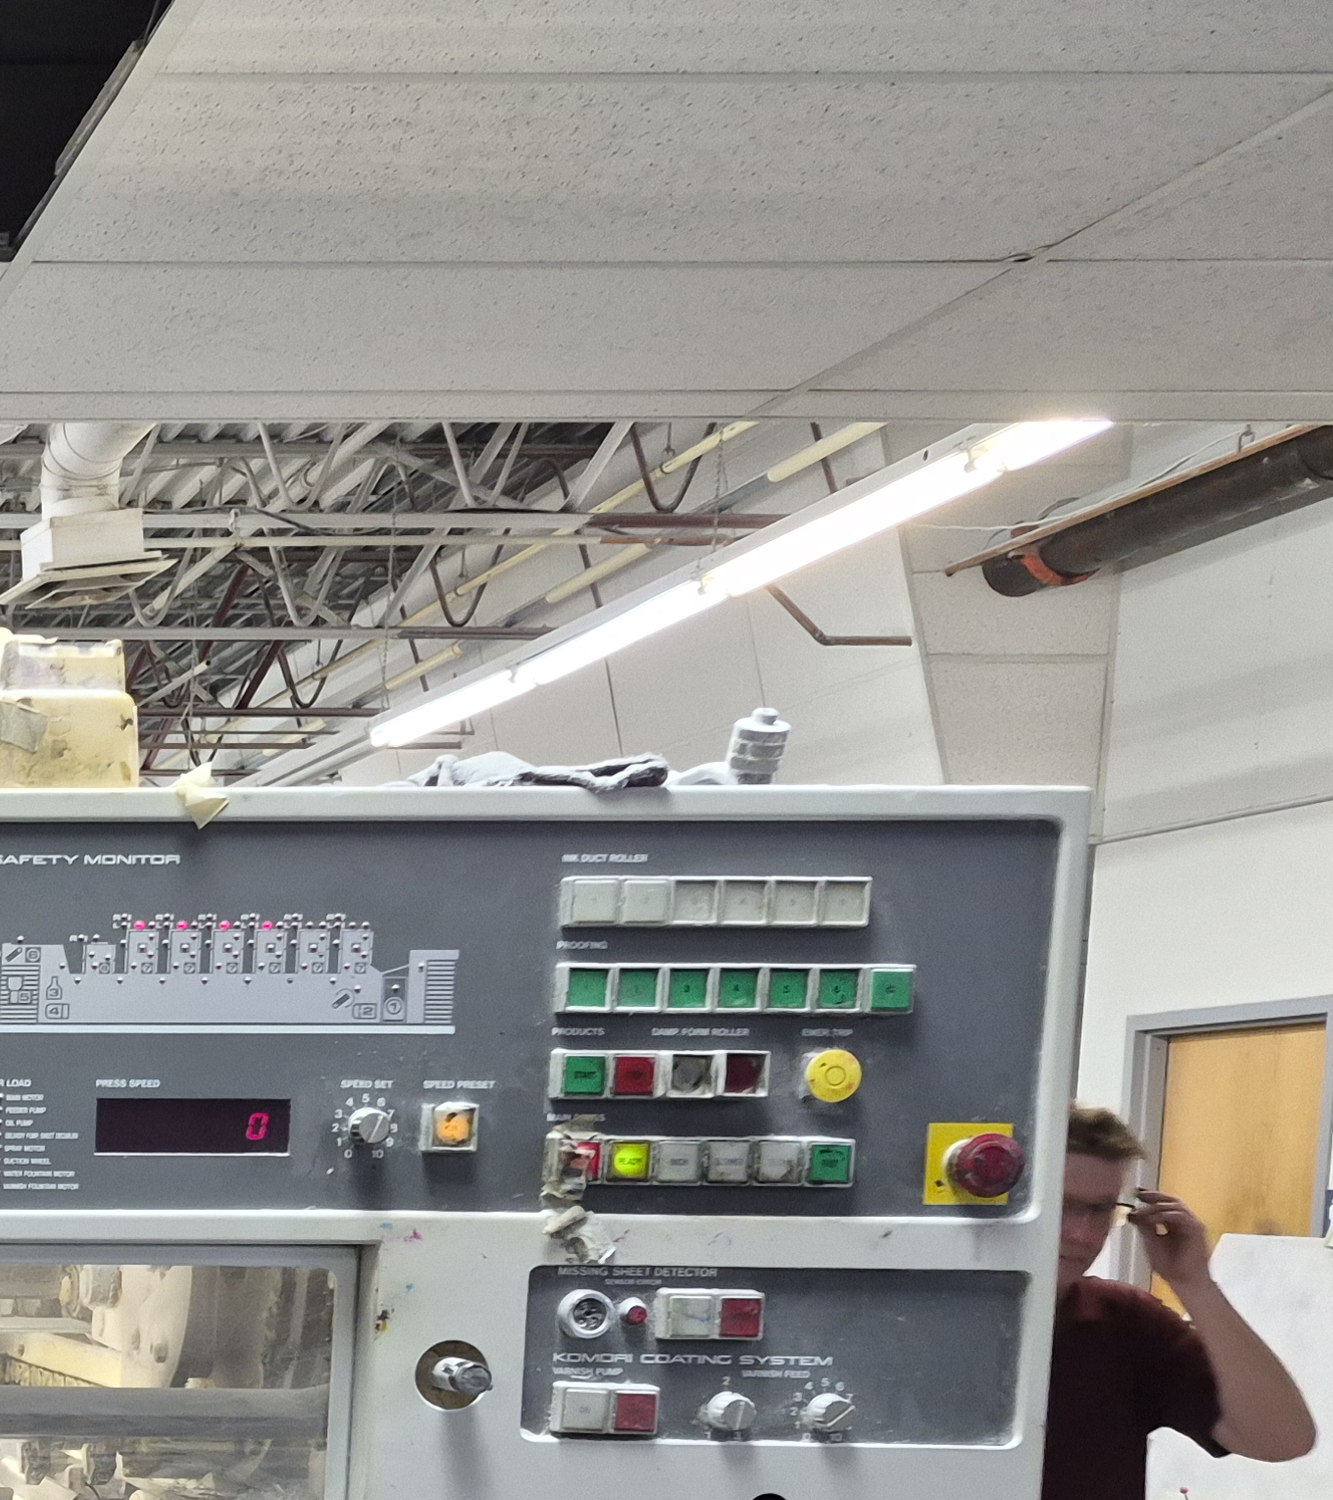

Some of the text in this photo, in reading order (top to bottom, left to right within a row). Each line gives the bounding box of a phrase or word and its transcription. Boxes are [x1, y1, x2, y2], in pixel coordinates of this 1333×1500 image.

[83, 854, 181, 865] MONITOR
[608, 854, 648, 862] ROLLER
[6, 1079, 32, 1087] LOAD
[96, 1079, 160, 1088] PRESS SPEED
[340, 1080, 394, 1088] SPEED SET
[423, 1080, 496, 1089] SPEED PRESET
[245, 1112, 269, 1140] 0
[557, 1266, 718, 1278] MISSING SHEET DETECTOR
[553, 1353, 834, 1366] KOMORI COATING SYSTEM
